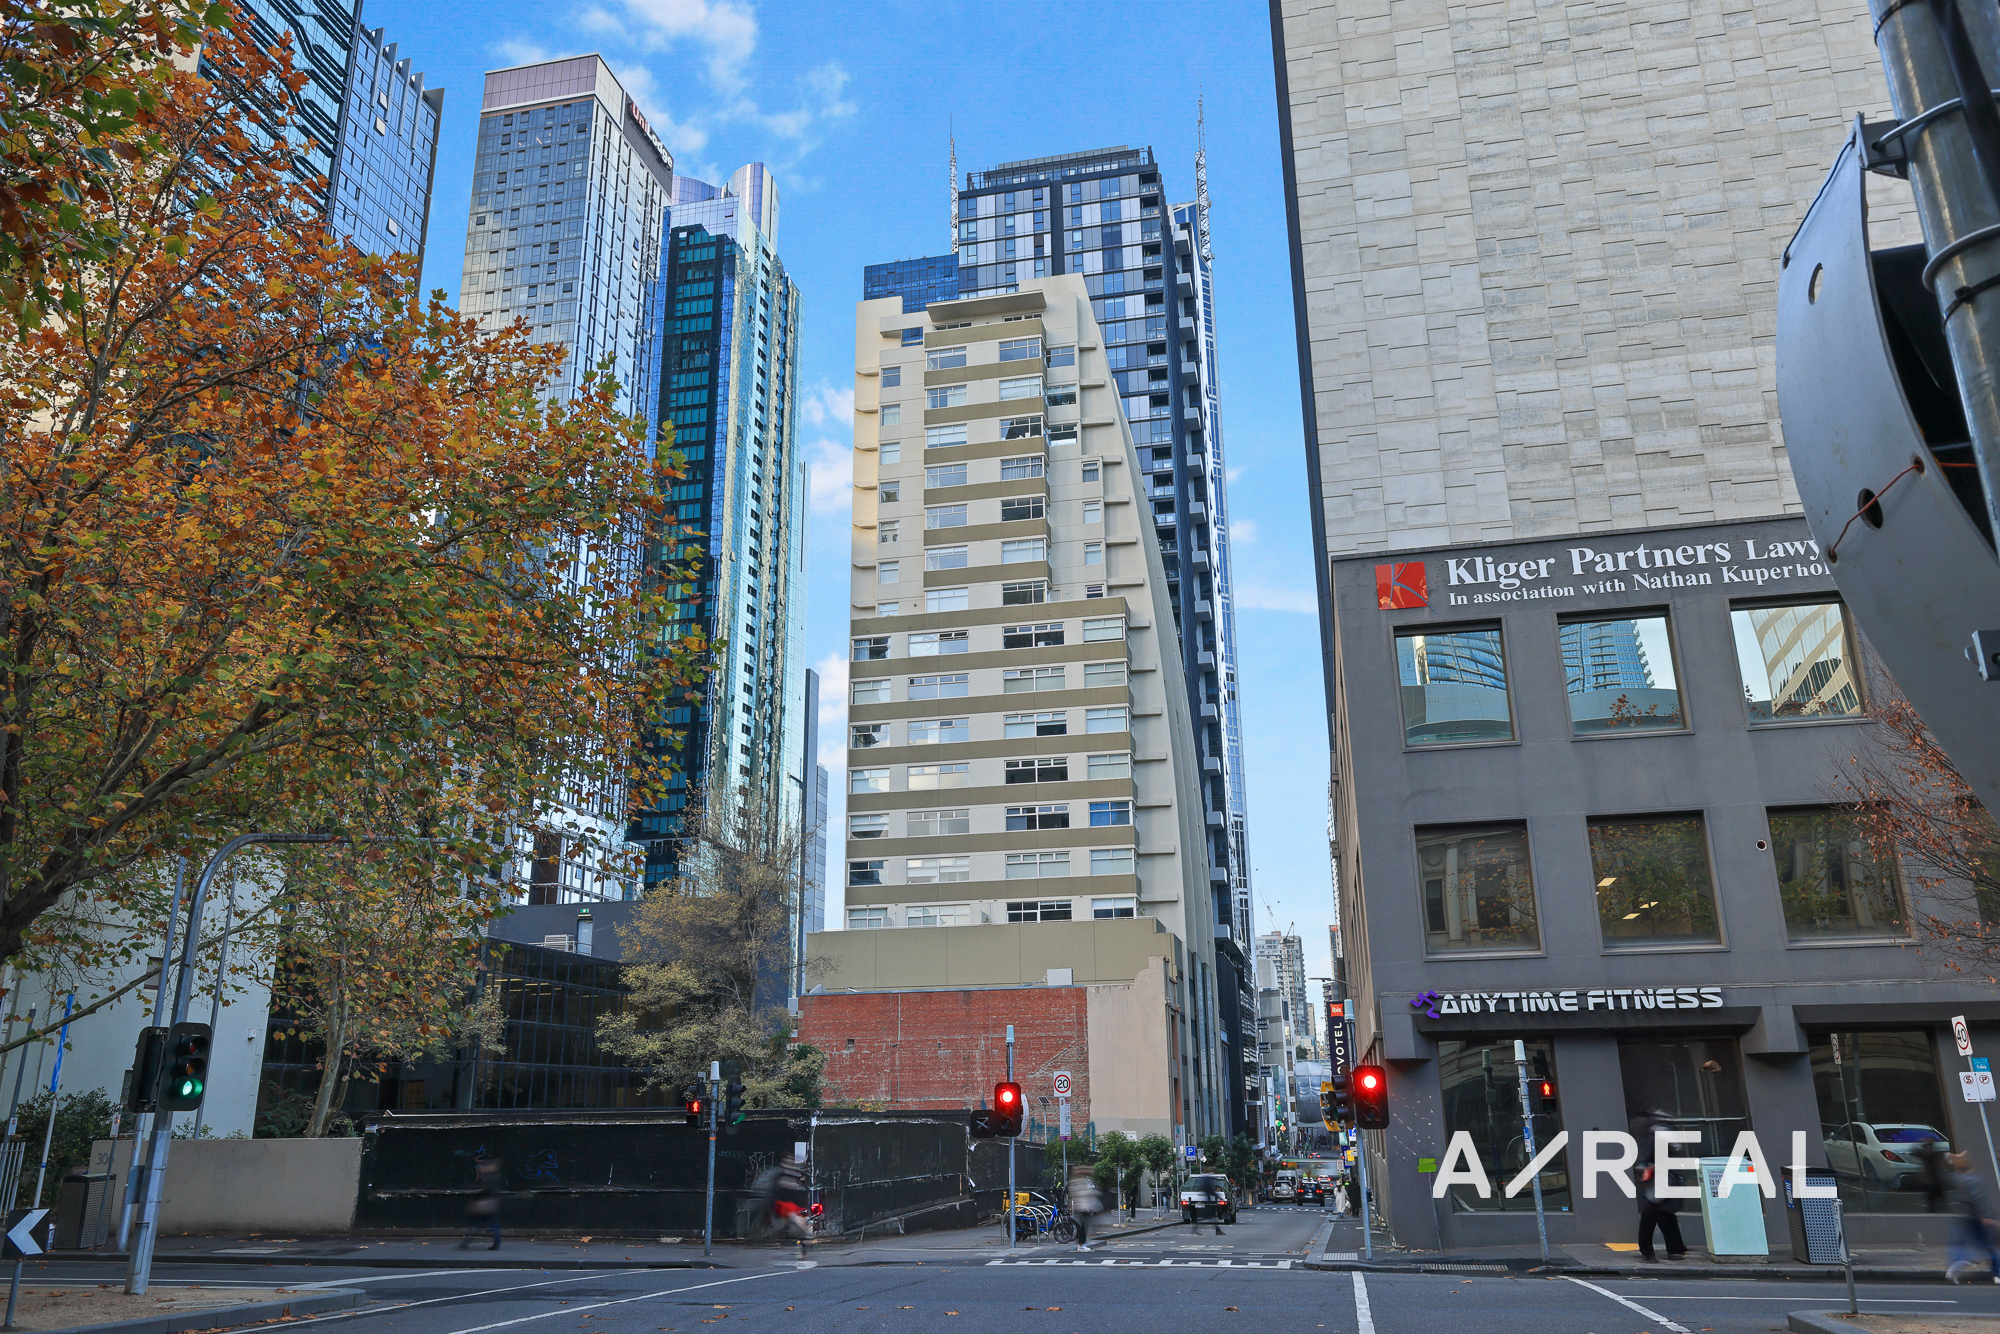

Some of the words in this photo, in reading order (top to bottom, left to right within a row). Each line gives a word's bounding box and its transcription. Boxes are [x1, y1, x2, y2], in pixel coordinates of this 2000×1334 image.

[631, 102, 673, 168] UniLodge
[1445, 556, 1556, 590] Kliger
[1566, 541, 1732, 576] Partners
[1448, 592, 1468, 606] In
[1473, 585, 1575, 604] association
[1582, 578, 1626, 597] with
[1632, 570, 1712, 591] Nathan
[1440, 990, 1579, 1014] ANYTIME
[1587, 987, 1724, 1011] FITNESS
[1957, 1028, 1967, 1043] 40
[1057, 1079, 1069, 1089] 20
